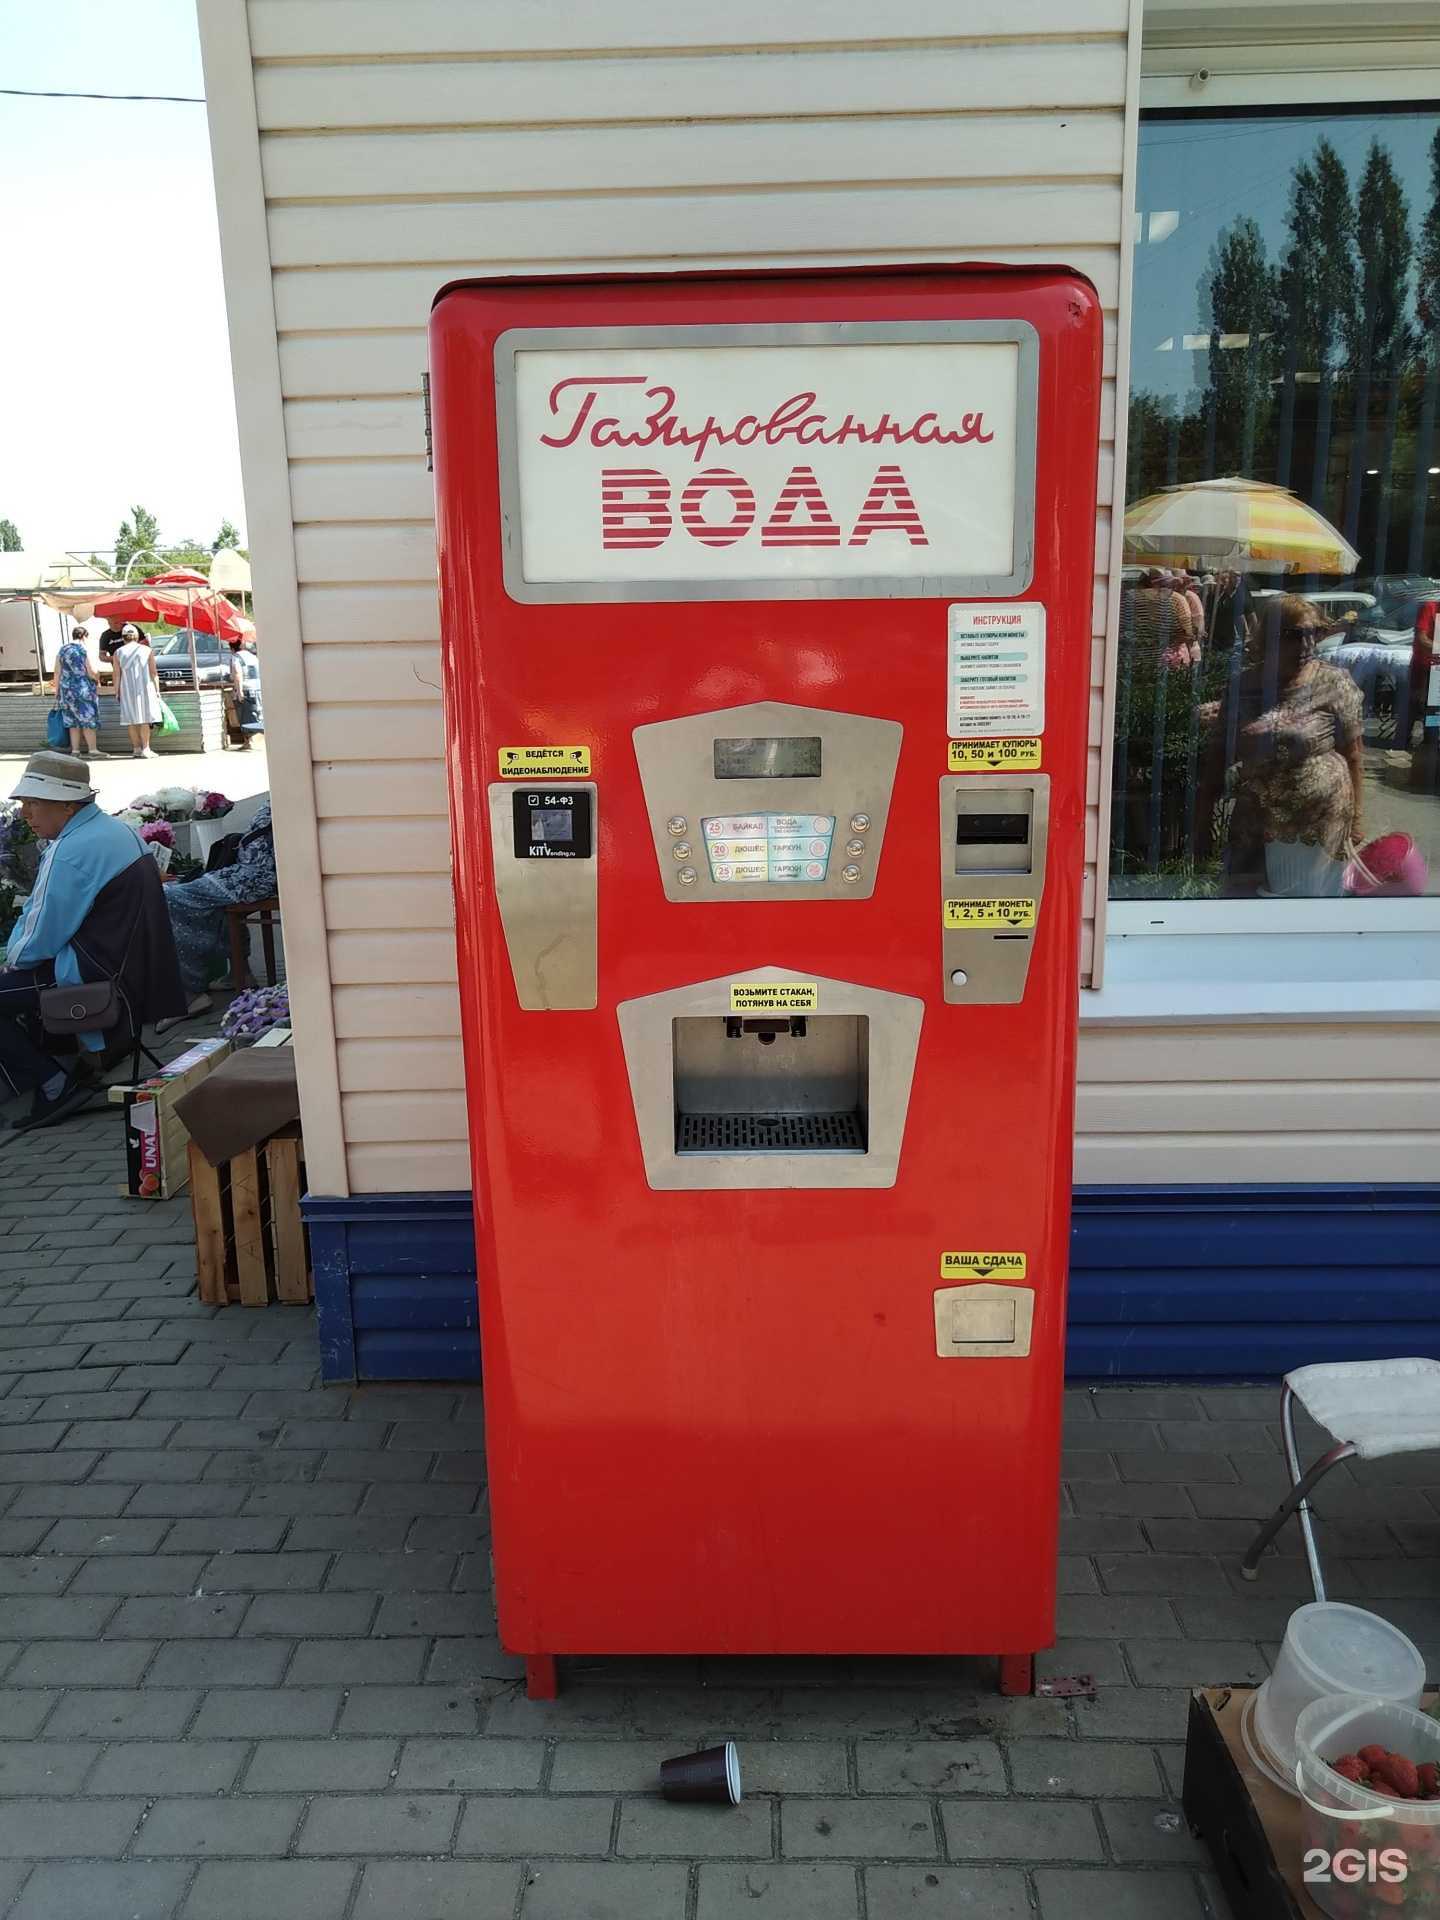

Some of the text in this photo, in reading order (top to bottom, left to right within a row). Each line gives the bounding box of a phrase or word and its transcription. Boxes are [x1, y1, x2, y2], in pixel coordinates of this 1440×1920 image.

[538, 376, 995, 463] Газированная
[601, 465, 930, 551] ВОДА
[972, 615, 1022, 625] ИНСТРУКЦИЯ
[952, 740, 1037, 749] ПРИНИМАЕТ КУПЮРЫ
[525, 749, 564, 759] ВЕДЁТСЯ
[952, 750, 967, 760] 10,
[971, 750, 984, 758] 50
[998, 749, 1017, 758] 100
[502, 766, 589, 775] ВИДЕОНАБЛЮДЕНИЕ
[735, 866, 766, 874] ДЮШЕС
[998, 900, 1032, 908] МОНЕТЫ
[950, 909, 960, 919] 1,
[963, 909, 973, 918] 2,
[977, 909, 984, 918] 5
[997, 908, 1010, 917] 10
[733, 988, 815, 996] ВОЗЬМИТЕ СТАКАН,
[945, 1255, 1023, 1267] ВАША СДАЧА
